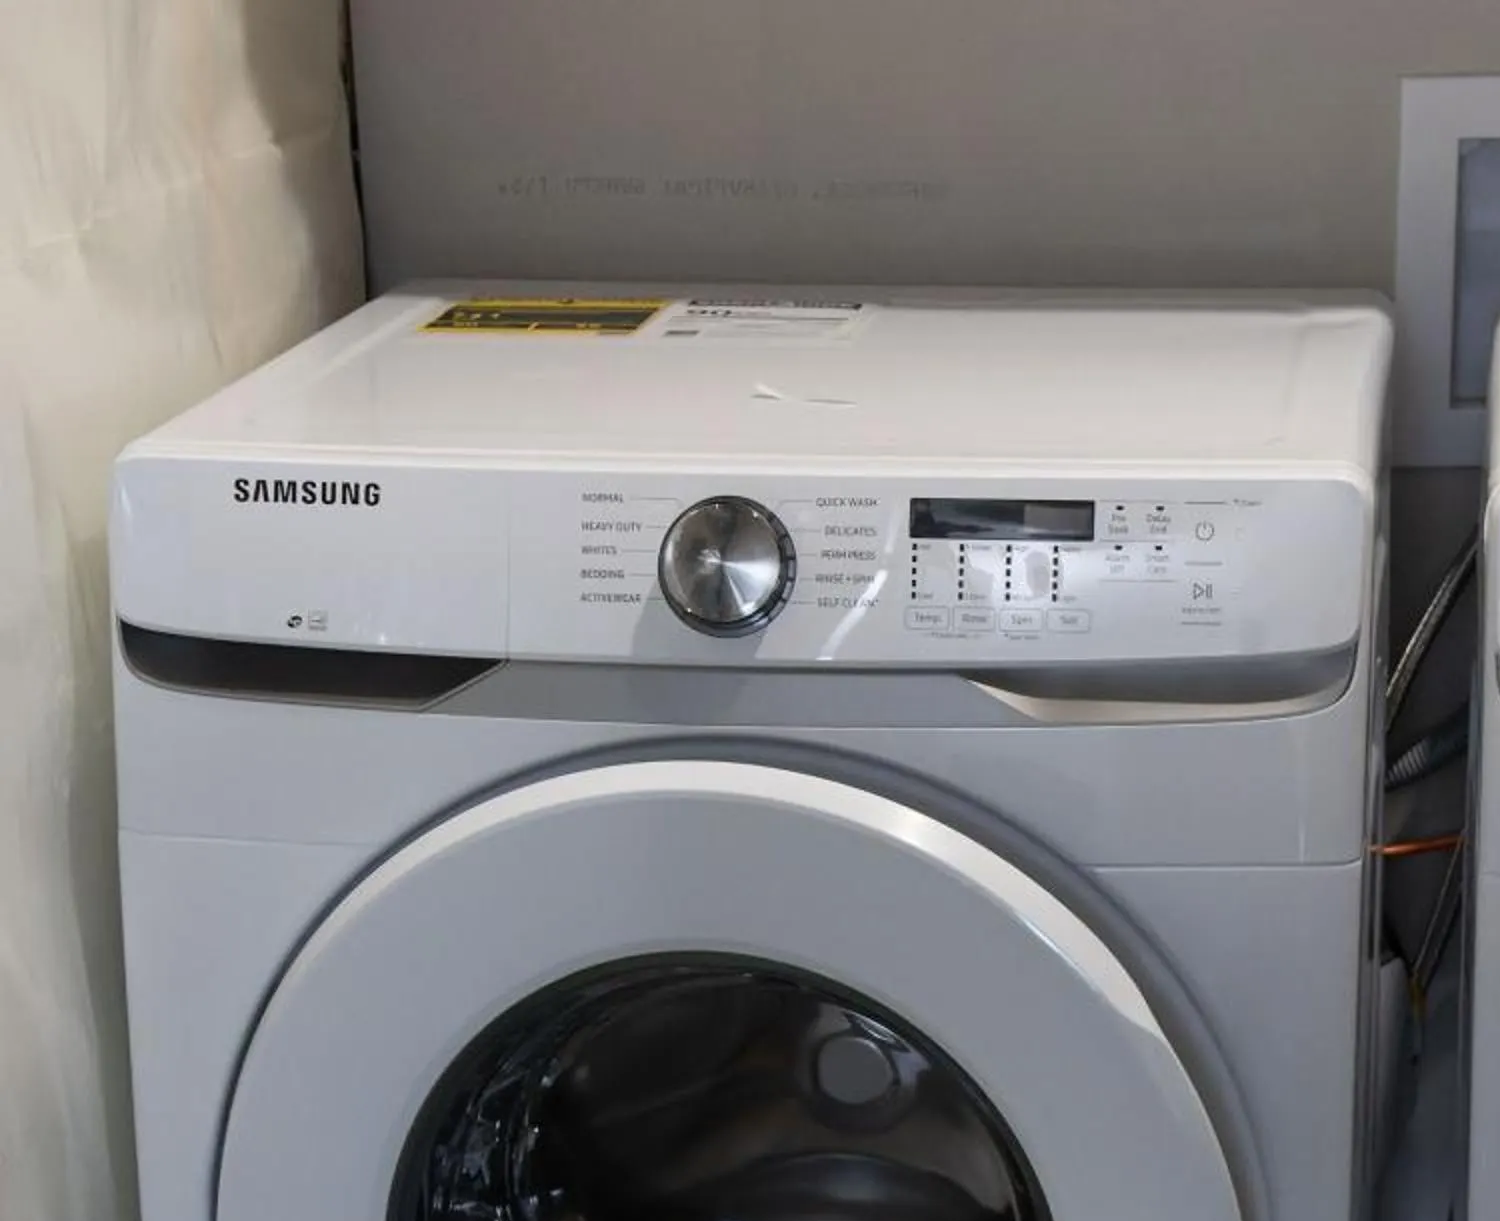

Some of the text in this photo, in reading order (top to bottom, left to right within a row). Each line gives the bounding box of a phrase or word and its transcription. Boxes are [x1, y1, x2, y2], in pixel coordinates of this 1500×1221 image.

[233, 477, 382, 507] SAMSUNG
[581, 493, 624, 503] NORMAL
[815, 497, 879, 508] QUICK WASH
[581, 521, 643, 532] HEAVY DUTY
[824, 525, 878, 537] DELICATES
[581, 545, 618, 555] WHITES
[847, 550, 877, 561] PRESS
[580, 569, 625, 579] BEDDING
[815, 573, 845, 583] RINSE
[580, 592, 641, 603] ACTIVEWEAR
[817, 597, 840, 608] SELF
